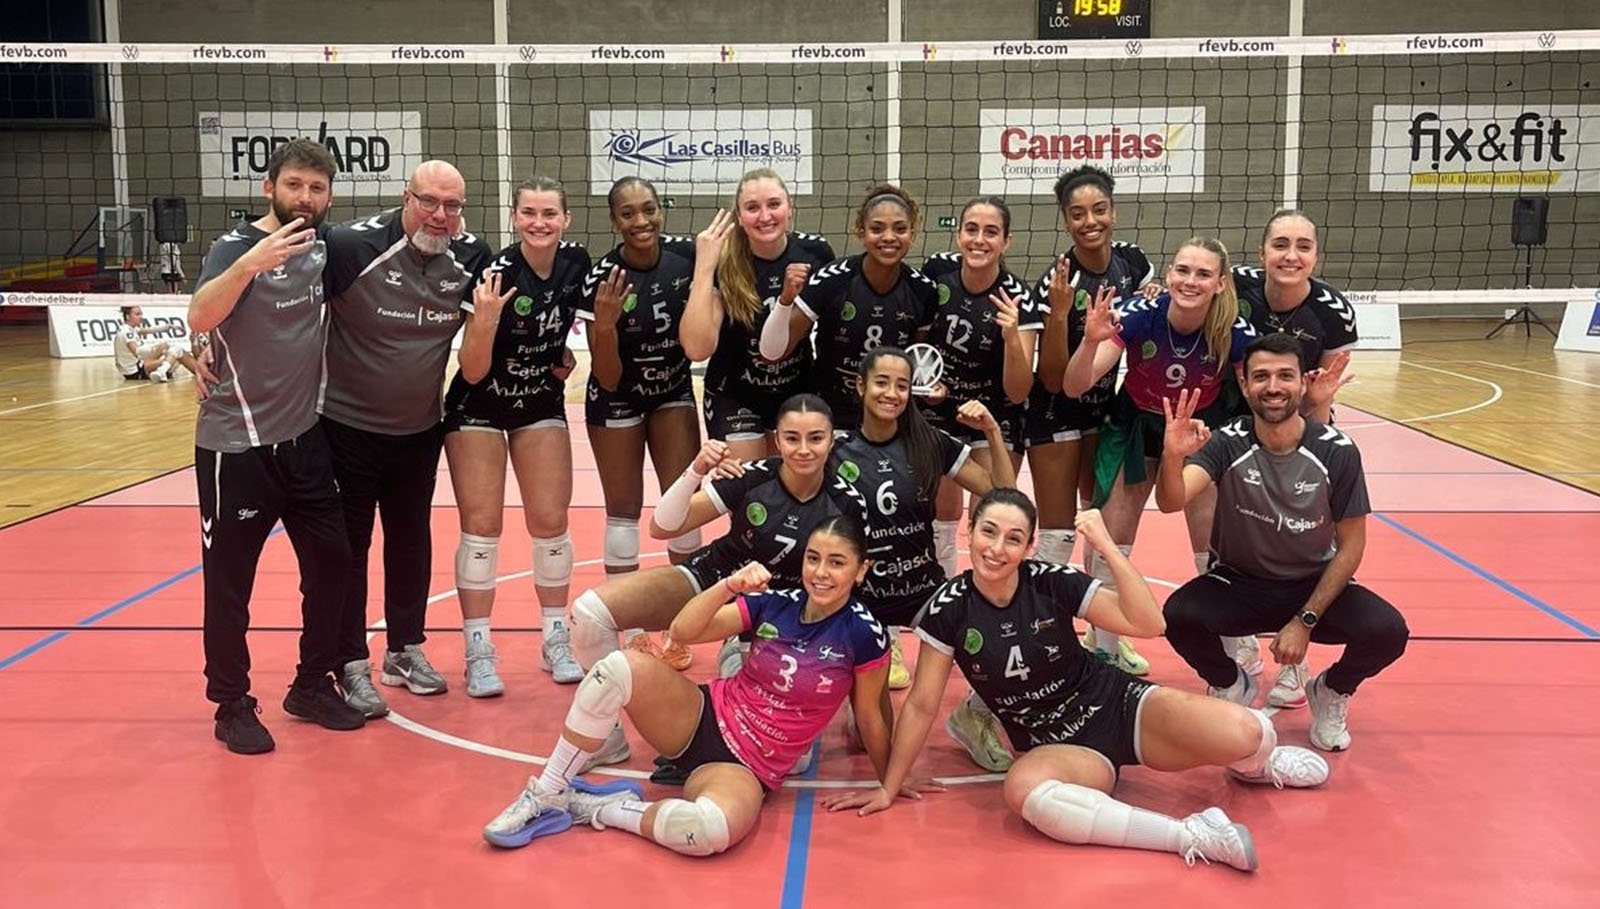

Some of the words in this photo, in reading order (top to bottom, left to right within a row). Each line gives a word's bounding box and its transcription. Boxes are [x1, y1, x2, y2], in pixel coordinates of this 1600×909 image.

[0, 45, 67, 58] fevb.com
[193, 46, 266, 59] rfevb.com
[391, 46, 465, 60] rfevb.com
[591, 46, 665, 59] rfevb.com
[792, 45, 866, 58] rfevb.com
[993, 43, 1068, 56] rfevb.com
[1199, 39, 1275, 53] rfevb.com
[1406, 36, 1484, 50] rfevb.com
[231, 122, 390, 174] FOARD
[668, 141, 698, 156] Las
[701, 139, 771, 156] Casillas
[773, 140, 802, 156] Bus
[1000, 126, 1164, 161] Canarias
[1408, 112, 1567, 170] fix&fit
[8, 294, 85, 305] @cdheidelberg
[377, 307, 416, 319] Fundación
[536, 305, 564, 337] 14
[652, 301, 673, 333] 5
[864, 325, 884, 352] 8
[945, 314, 974, 354] 12
[1165, 363, 1187, 388] 9
[876, 480, 899, 516] 6
[768, 534, 797, 566] 7
[872, 548, 933, 577] Cajasol
[773, 654, 799, 692] 3
[1004, 645, 1031, 681] 4
